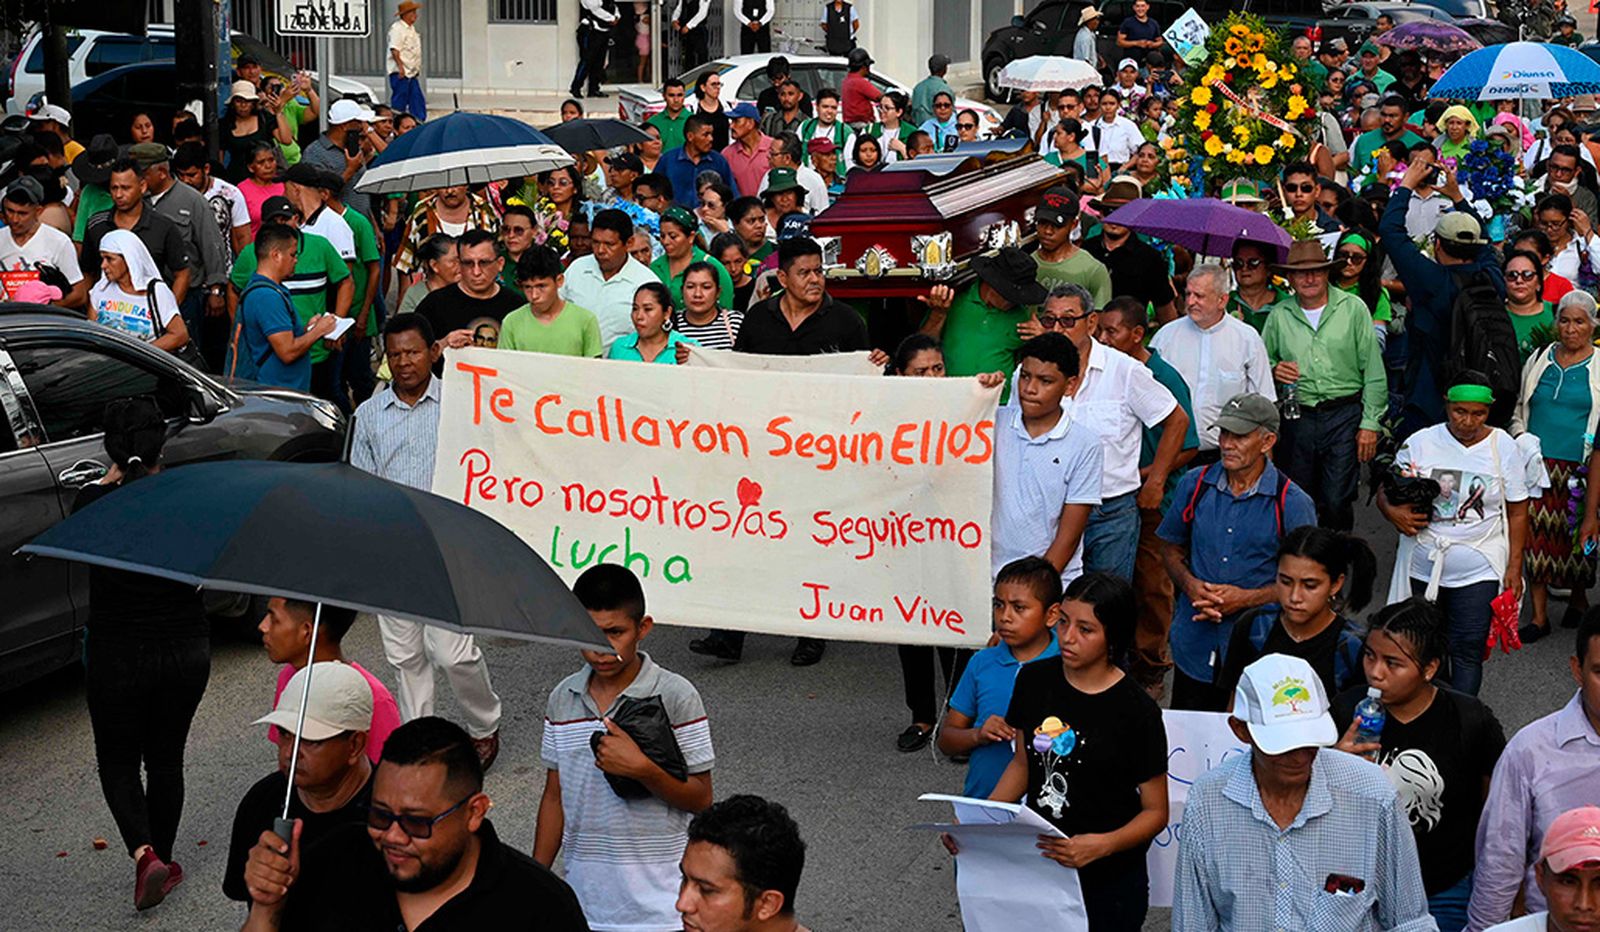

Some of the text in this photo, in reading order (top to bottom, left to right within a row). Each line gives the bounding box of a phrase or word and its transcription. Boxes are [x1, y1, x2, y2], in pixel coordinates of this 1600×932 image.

[99, 299, 152, 319] HONDURAS
[456, 361, 516, 425] Te
[534, 394, 749, 458] Callaron
[766, 411, 884, 471] Según
[459, 448, 544, 507] Pero
[799, 582, 966, 635] Juan Vive
